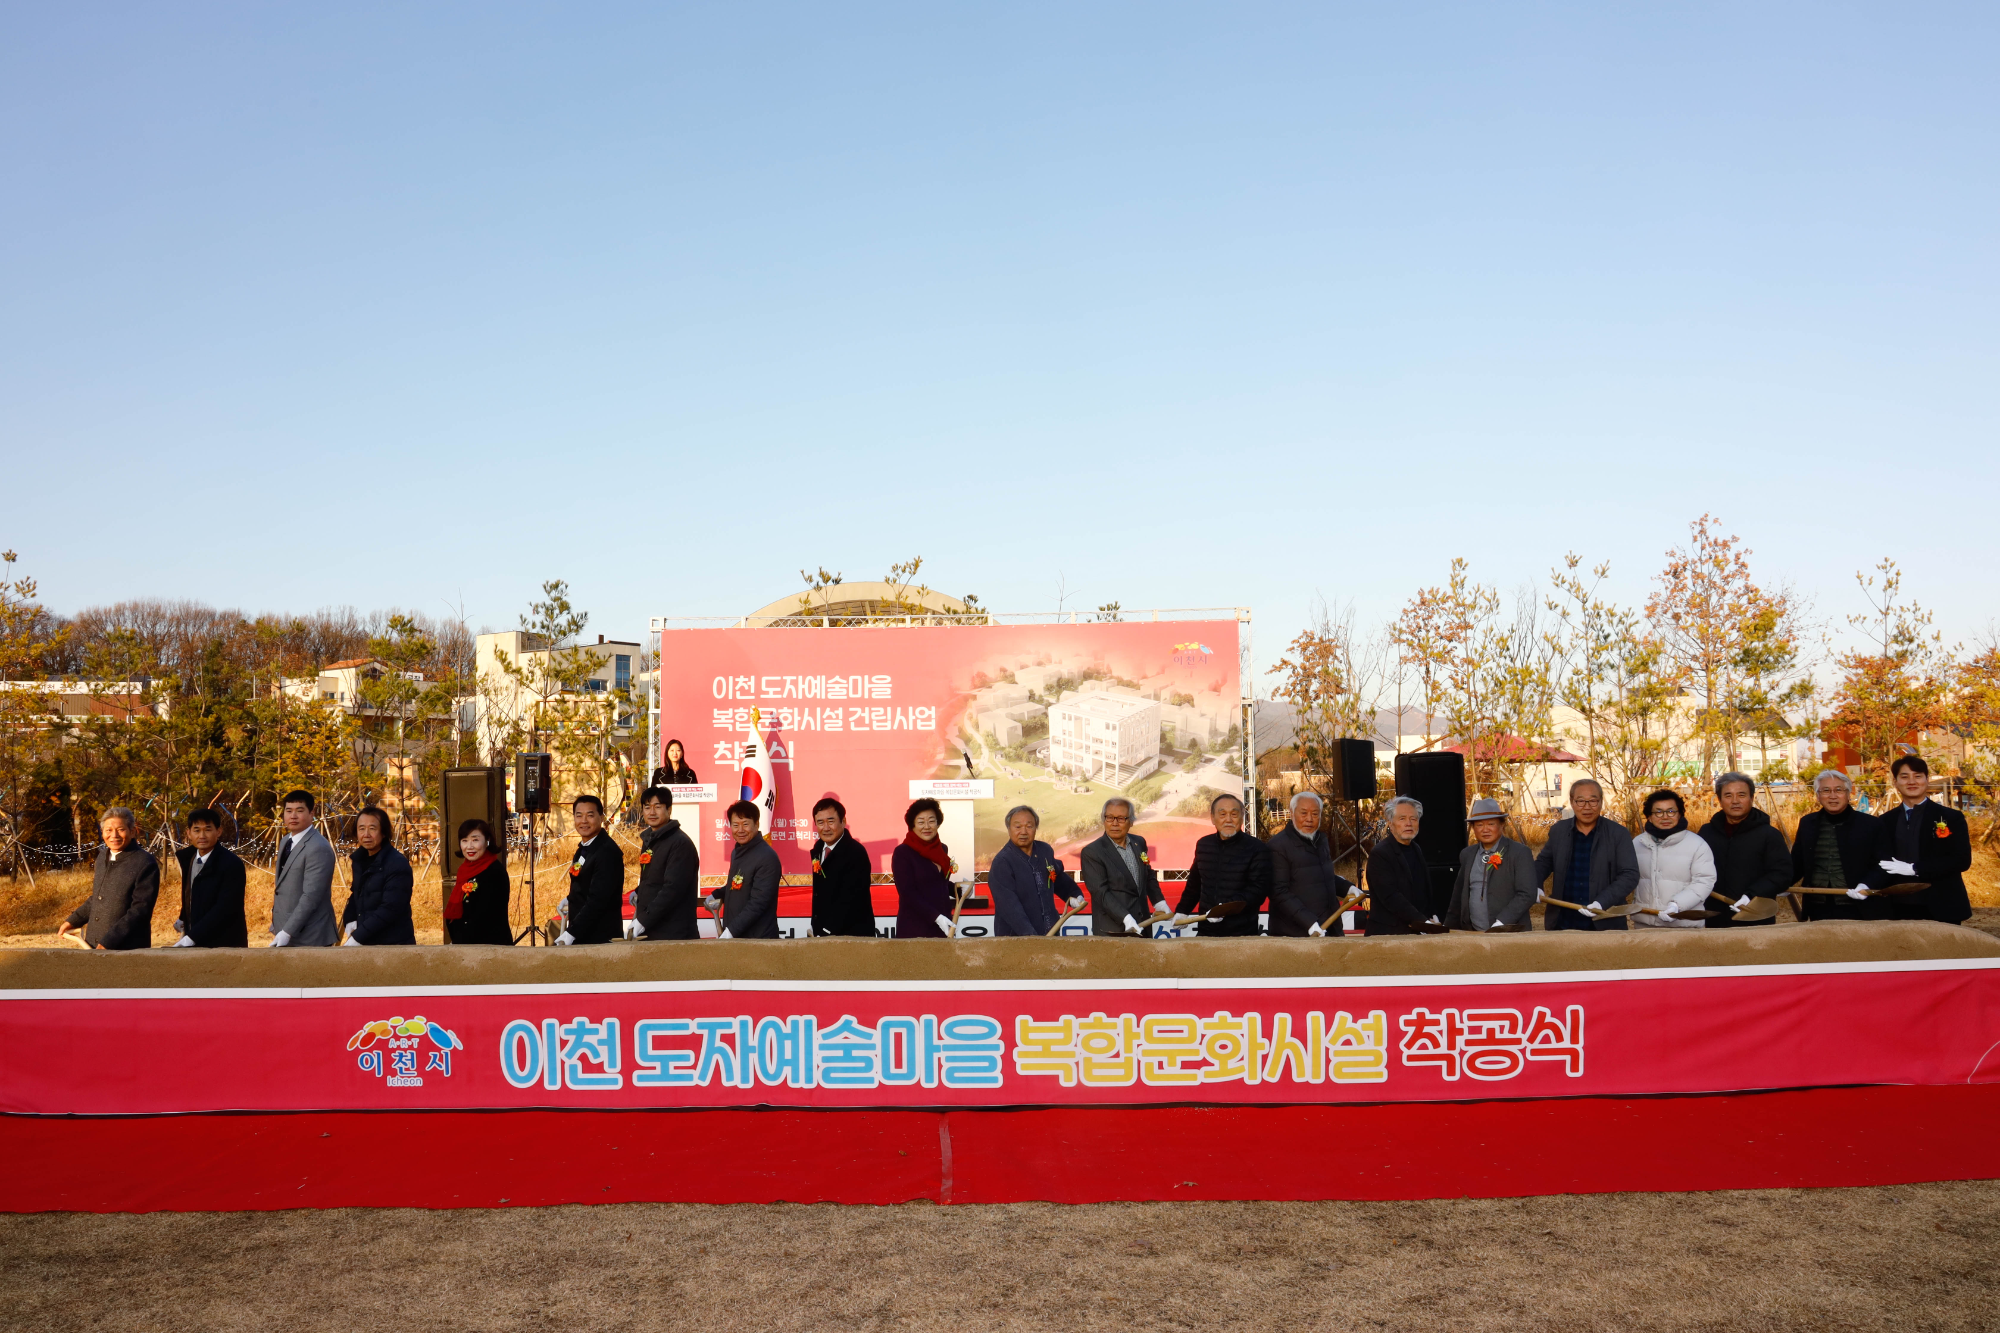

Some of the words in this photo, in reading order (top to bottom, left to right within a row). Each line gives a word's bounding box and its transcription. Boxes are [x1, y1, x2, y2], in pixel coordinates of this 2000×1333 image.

[1173, 655, 1208, 666] 이천시
[712, 675, 755, 699] 이천
[760, 675, 892, 699] 도자예술마을
[712, 707, 843, 731] 복합문화시설
[848, 706, 936, 731] 건립사업
[713, 740, 794, 772] 착식
[715, 818, 731, 829] 일시
[789, 818, 808, 828] 15:30
[715, 831, 731, 841] 장소
[788, 831, 811, 841] 고척리
[499, 1017, 623, 1091] 이천
[632, 1014, 1004, 1088] 도자예술마을
[1013, 1010, 1389, 1087] 복합문화시설
[1399, 1004, 1585, 1081] 착공식
[358, 1050, 451, 1077] 이천시
[386, 1075, 424, 1086] Icheon
